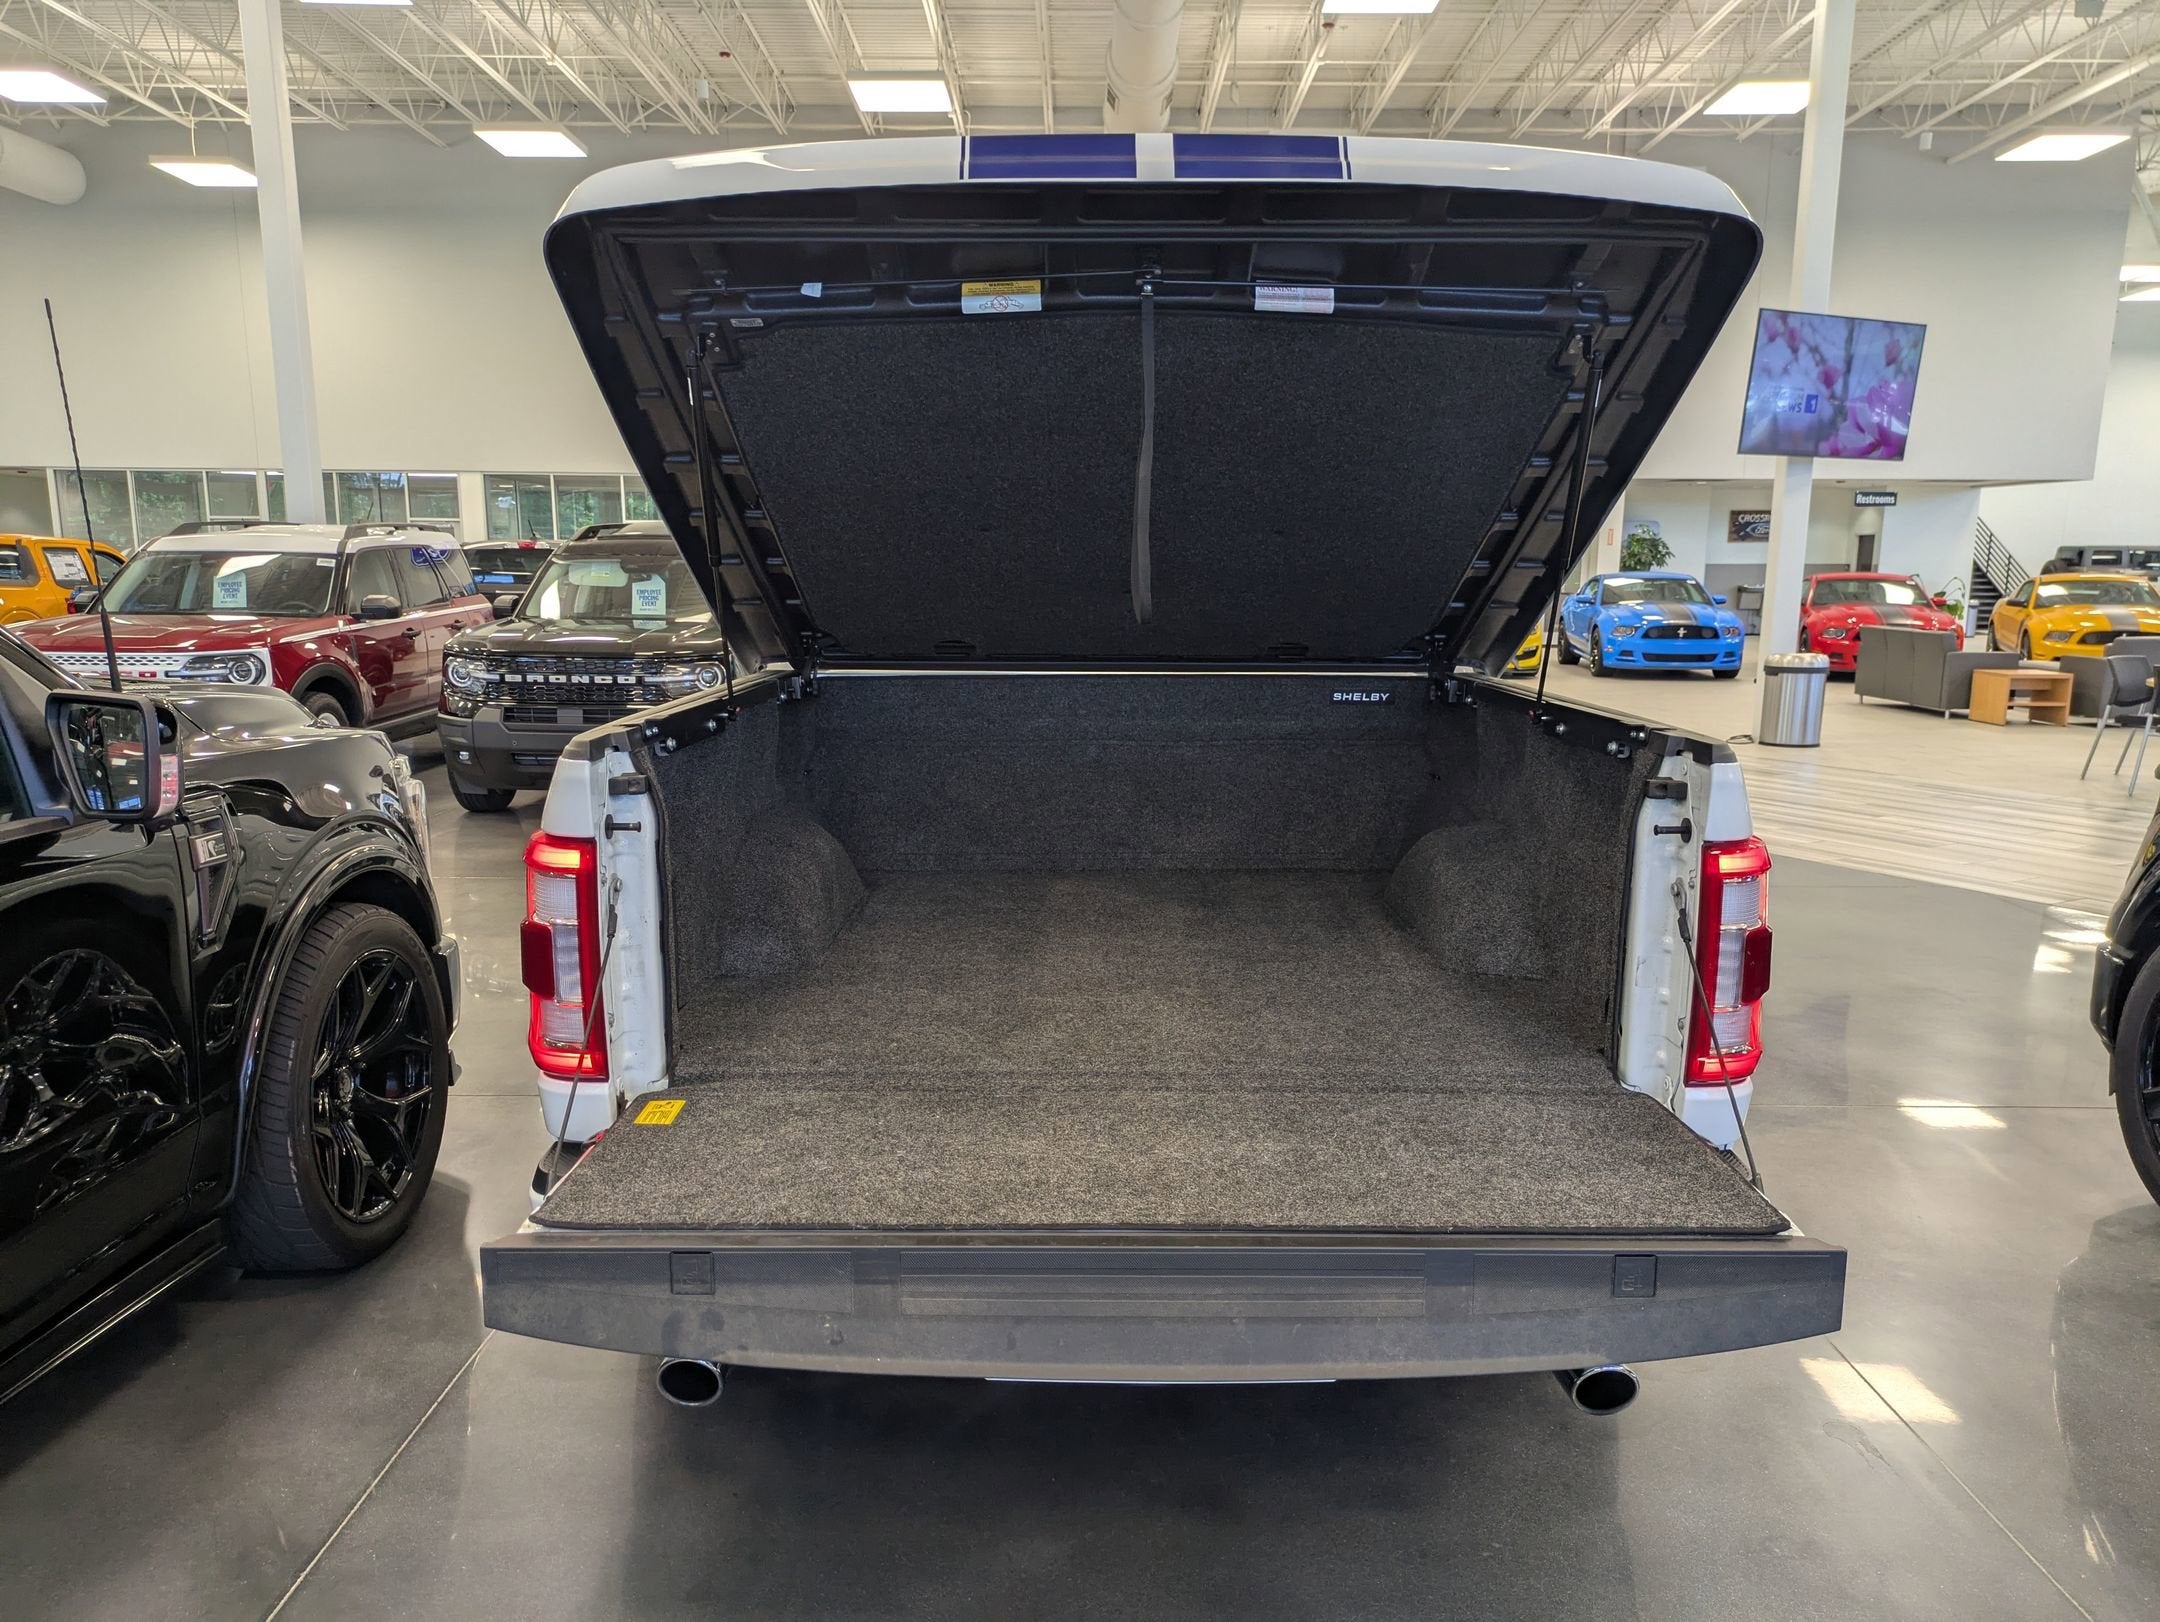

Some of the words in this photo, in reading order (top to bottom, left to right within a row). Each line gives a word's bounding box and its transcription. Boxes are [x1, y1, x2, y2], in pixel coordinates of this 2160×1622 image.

[1856, 494, 1895, 504] Restrooms
[504, 674, 637, 684] BRONCO
[1332, 692, 1390, 701] SHELBY
